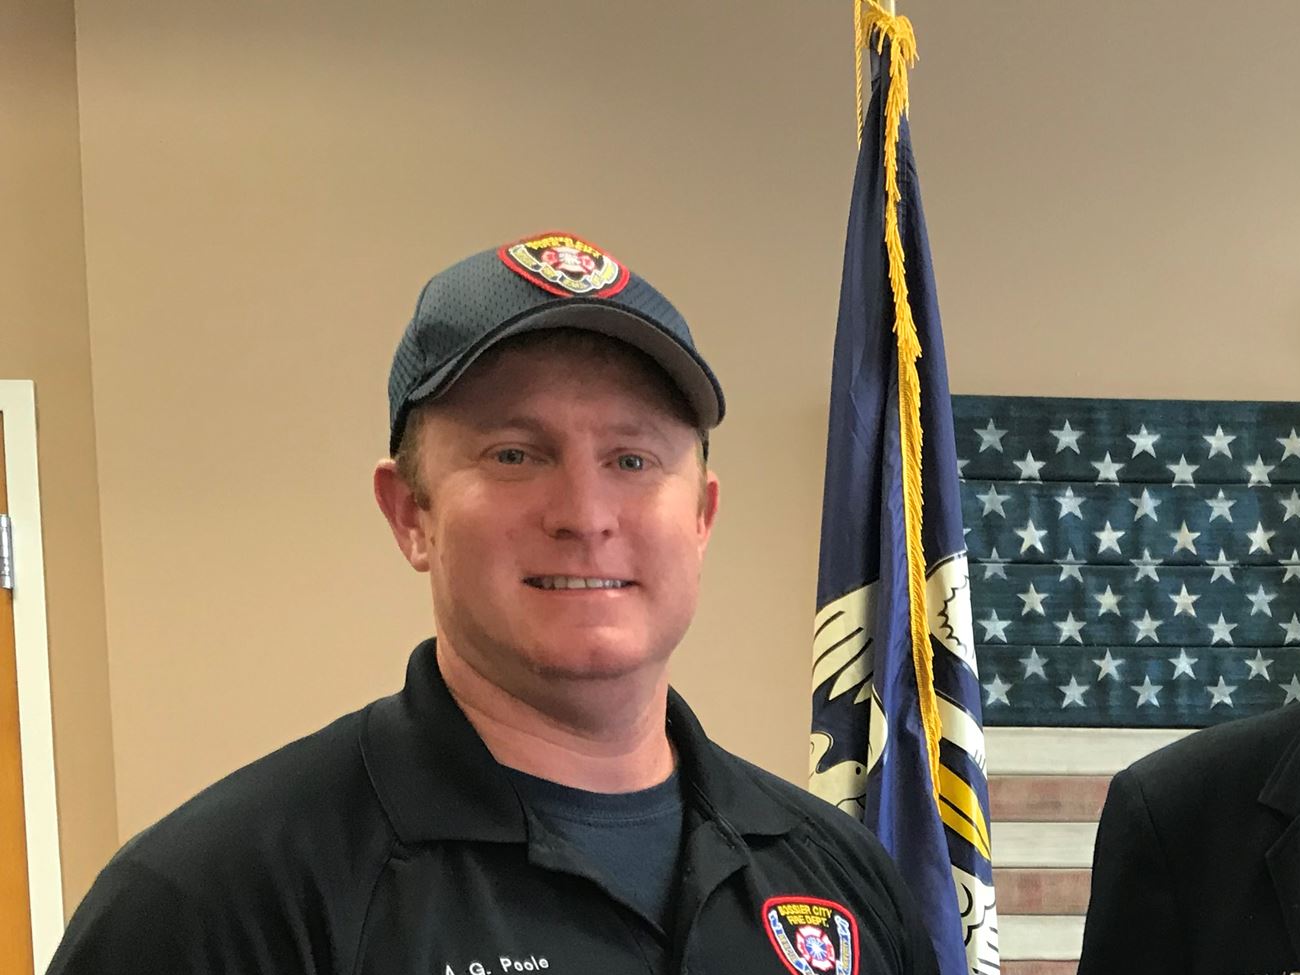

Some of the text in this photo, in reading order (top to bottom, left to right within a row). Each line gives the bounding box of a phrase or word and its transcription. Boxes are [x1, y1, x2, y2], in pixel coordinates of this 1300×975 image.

[777, 904, 833, 919] BOSSIER CITY
[786, 915, 806, 926] FIRE
[500, 955, 549, 973] Poole
